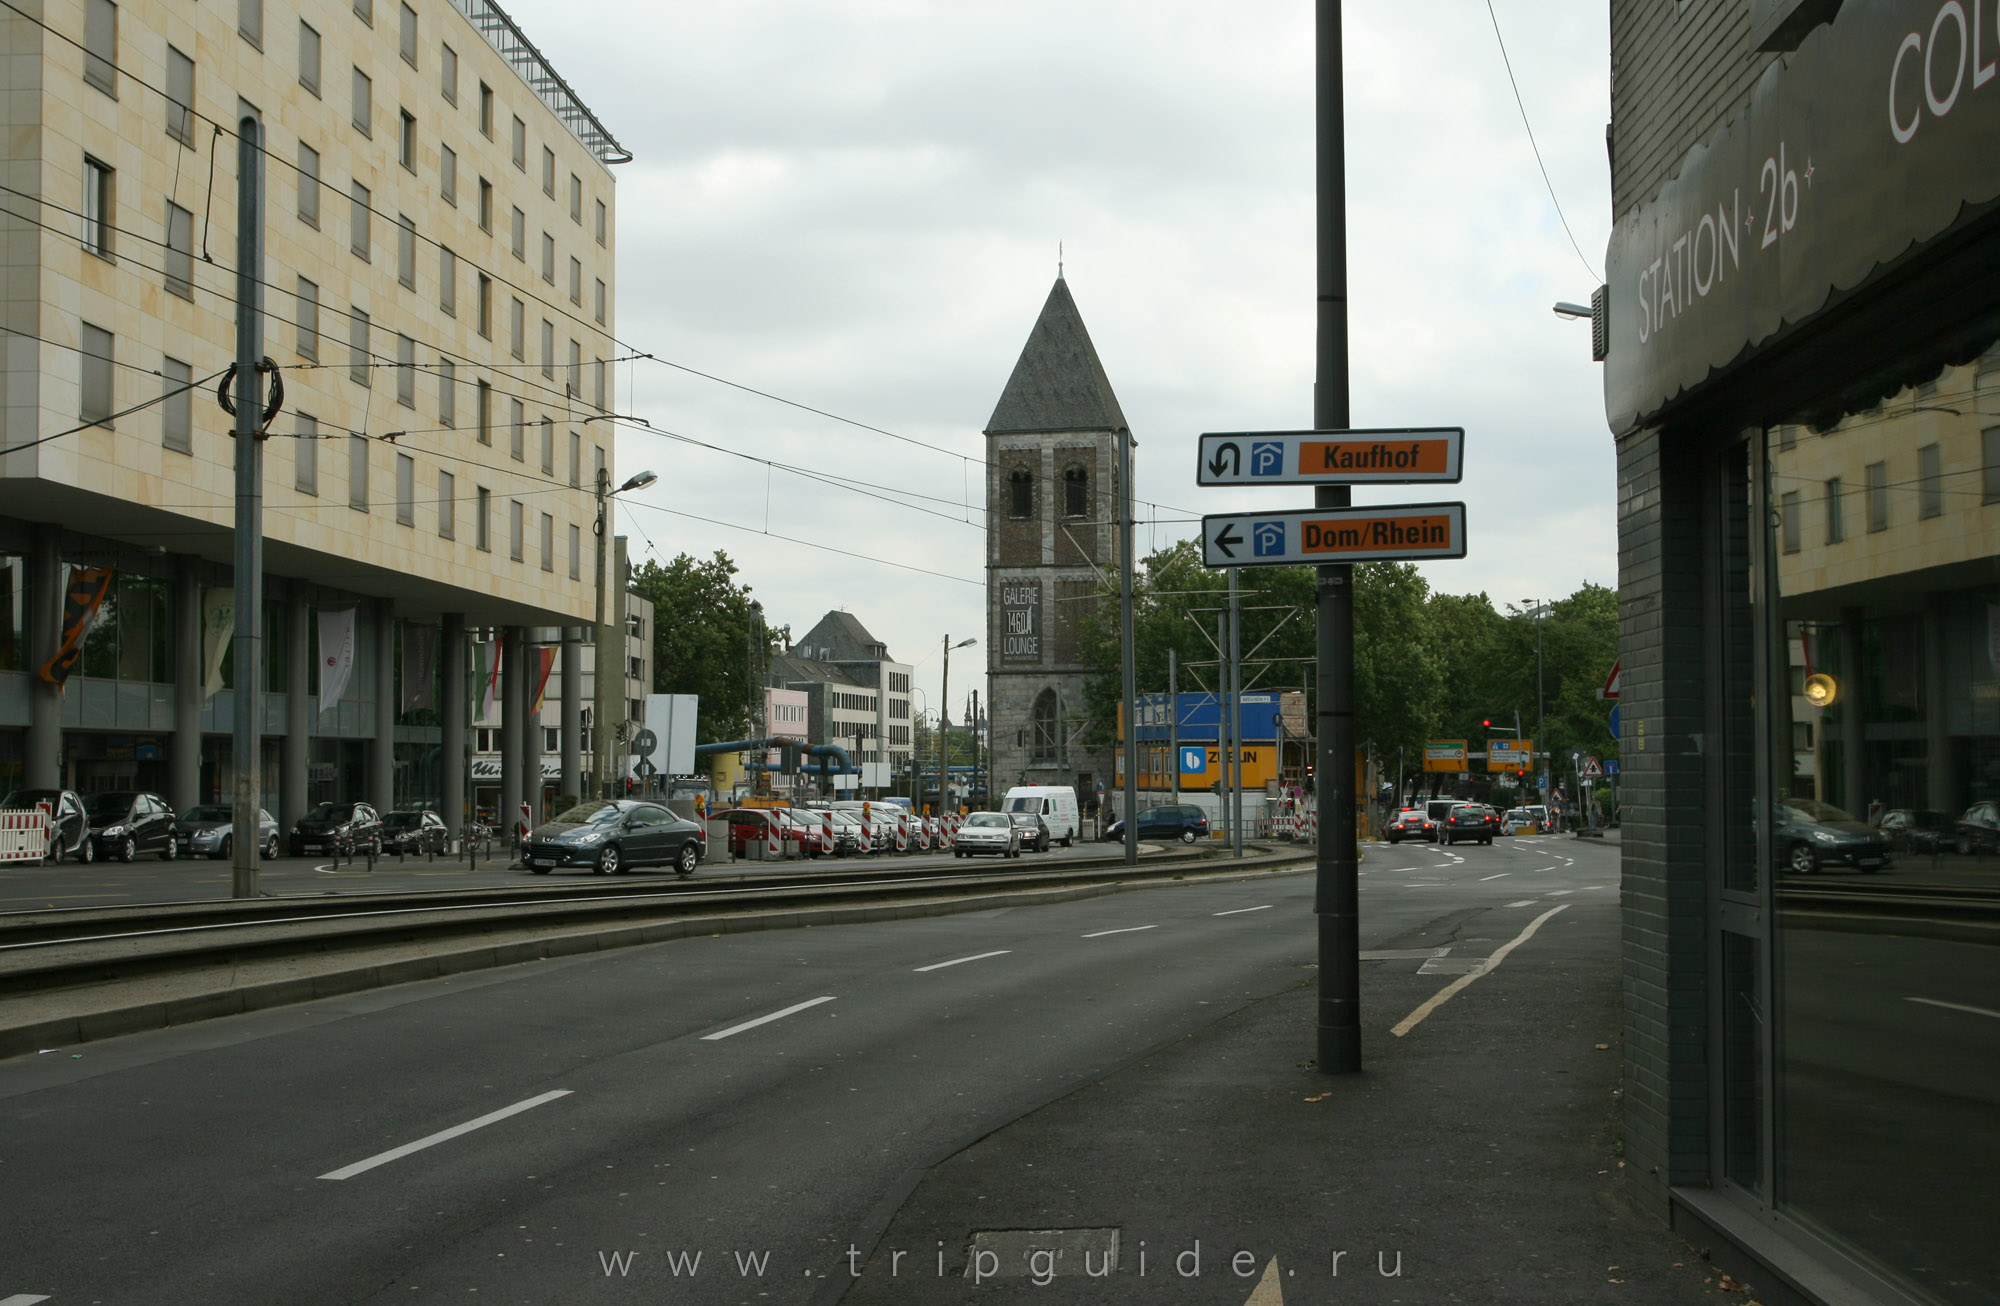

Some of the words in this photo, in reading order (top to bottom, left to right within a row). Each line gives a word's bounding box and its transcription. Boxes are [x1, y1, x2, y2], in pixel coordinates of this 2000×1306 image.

[1638, 187, 1740, 345] STATION
[1760, 140, 1799, 251] 2b
[1888, 0, 2000, 145] COL
[1324, 444, 1420, 469] Kaufhof
[1305, 519, 1445, 549] Dom/Rhein
[1004, 587, 1038, 605] GALERIE
[1007, 612, 1027, 633] 1460
[1004, 637, 1038, 655] LOUNGE
[1207, 751, 1257, 763] ZBIN
